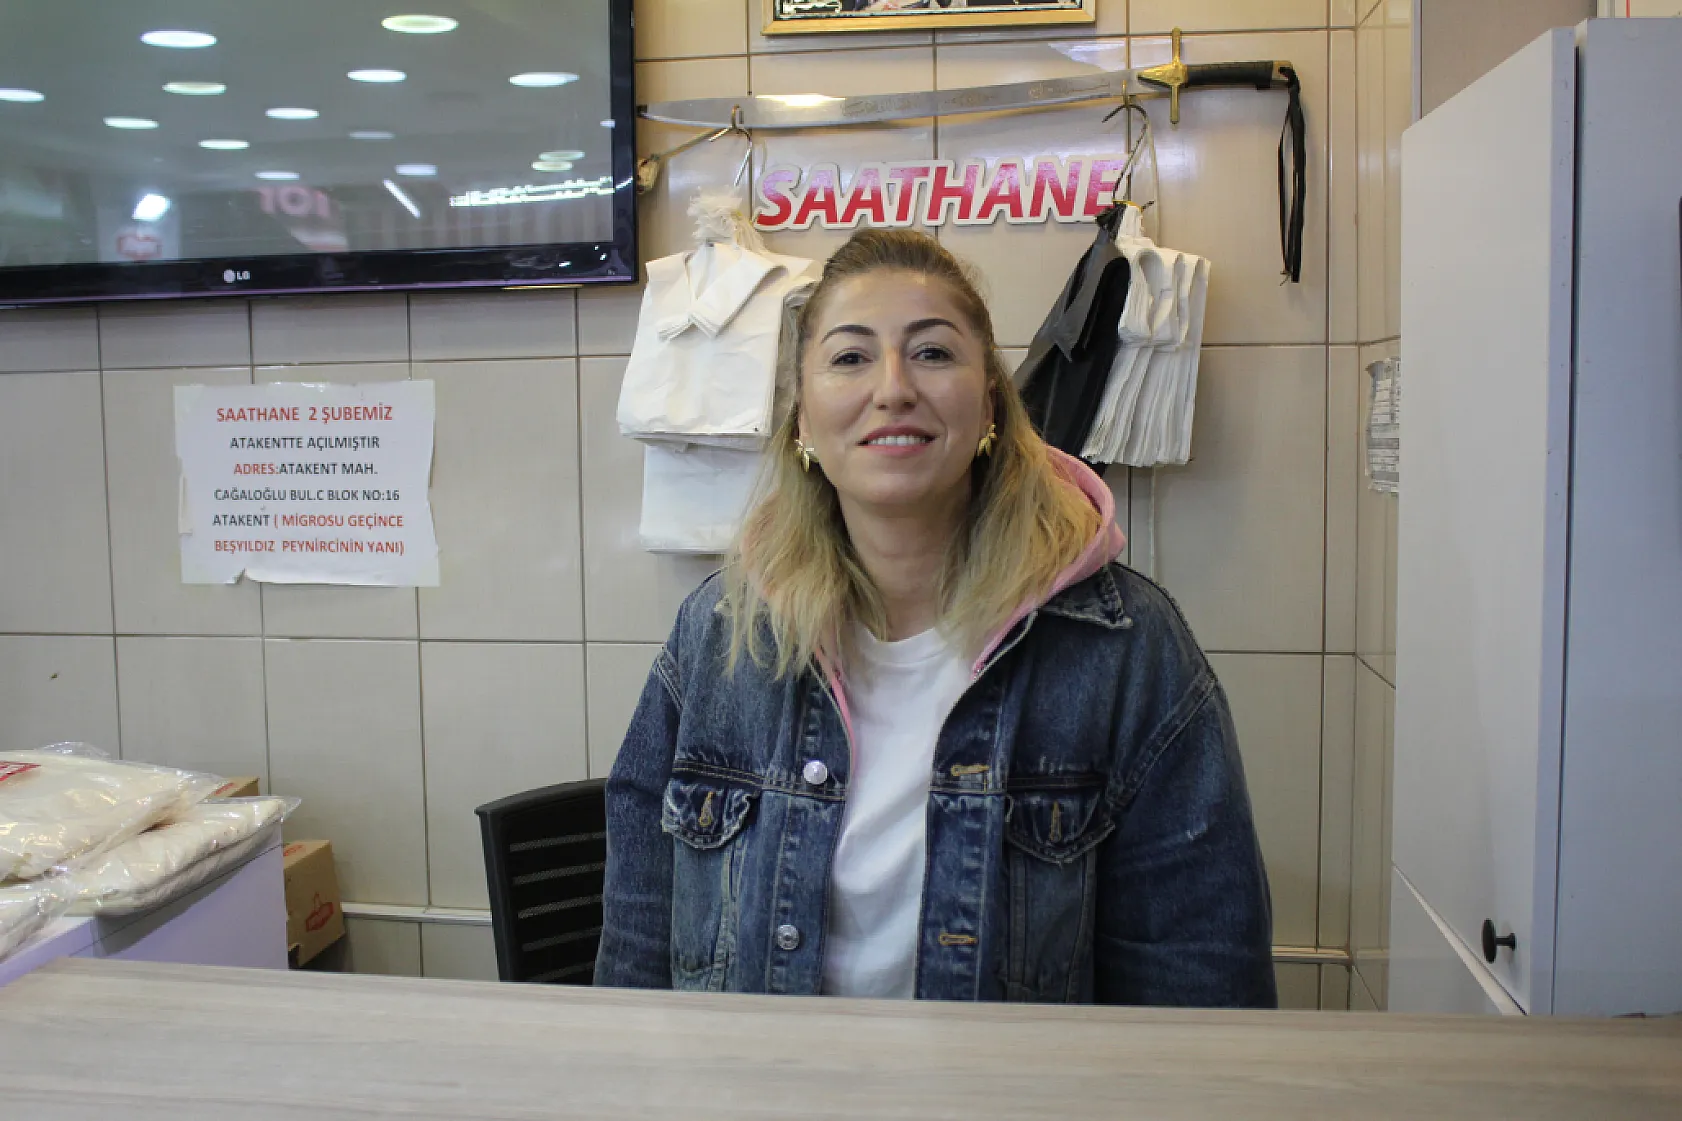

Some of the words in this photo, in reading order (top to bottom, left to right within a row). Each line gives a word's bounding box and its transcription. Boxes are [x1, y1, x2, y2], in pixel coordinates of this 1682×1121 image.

[755, 159, 1127, 227] SAATHANE
[217, 408, 300, 422] SAATHANE
[309, 407, 318, 421] 2
[322, 402, 393, 424] ŞUBEMİZ
[230, 437, 303, 449] ATAKENTTE
[307, 437, 380, 451] AÇILMIŞTIR
[234, 463, 337, 475] ADRES:ATAKENT
[341, 463, 378, 475] MAH.
[214, 487, 286, 501] CAĞALOĞLU
[289, 490, 325, 501] BUL.C
[327, 490, 359, 501] BLOK
[363, 490, 400, 501] NO:16
[212, 515, 270, 527] ATAKENT
[282, 514, 344, 527] MİGROSU
[348, 514, 405, 530] GEÇİNCE
[214, 540, 275, 555] BEŞYILDIZ
[282, 538, 363, 553] PEYNİRCİNİN
[366, 541, 406, 557] YANI)
